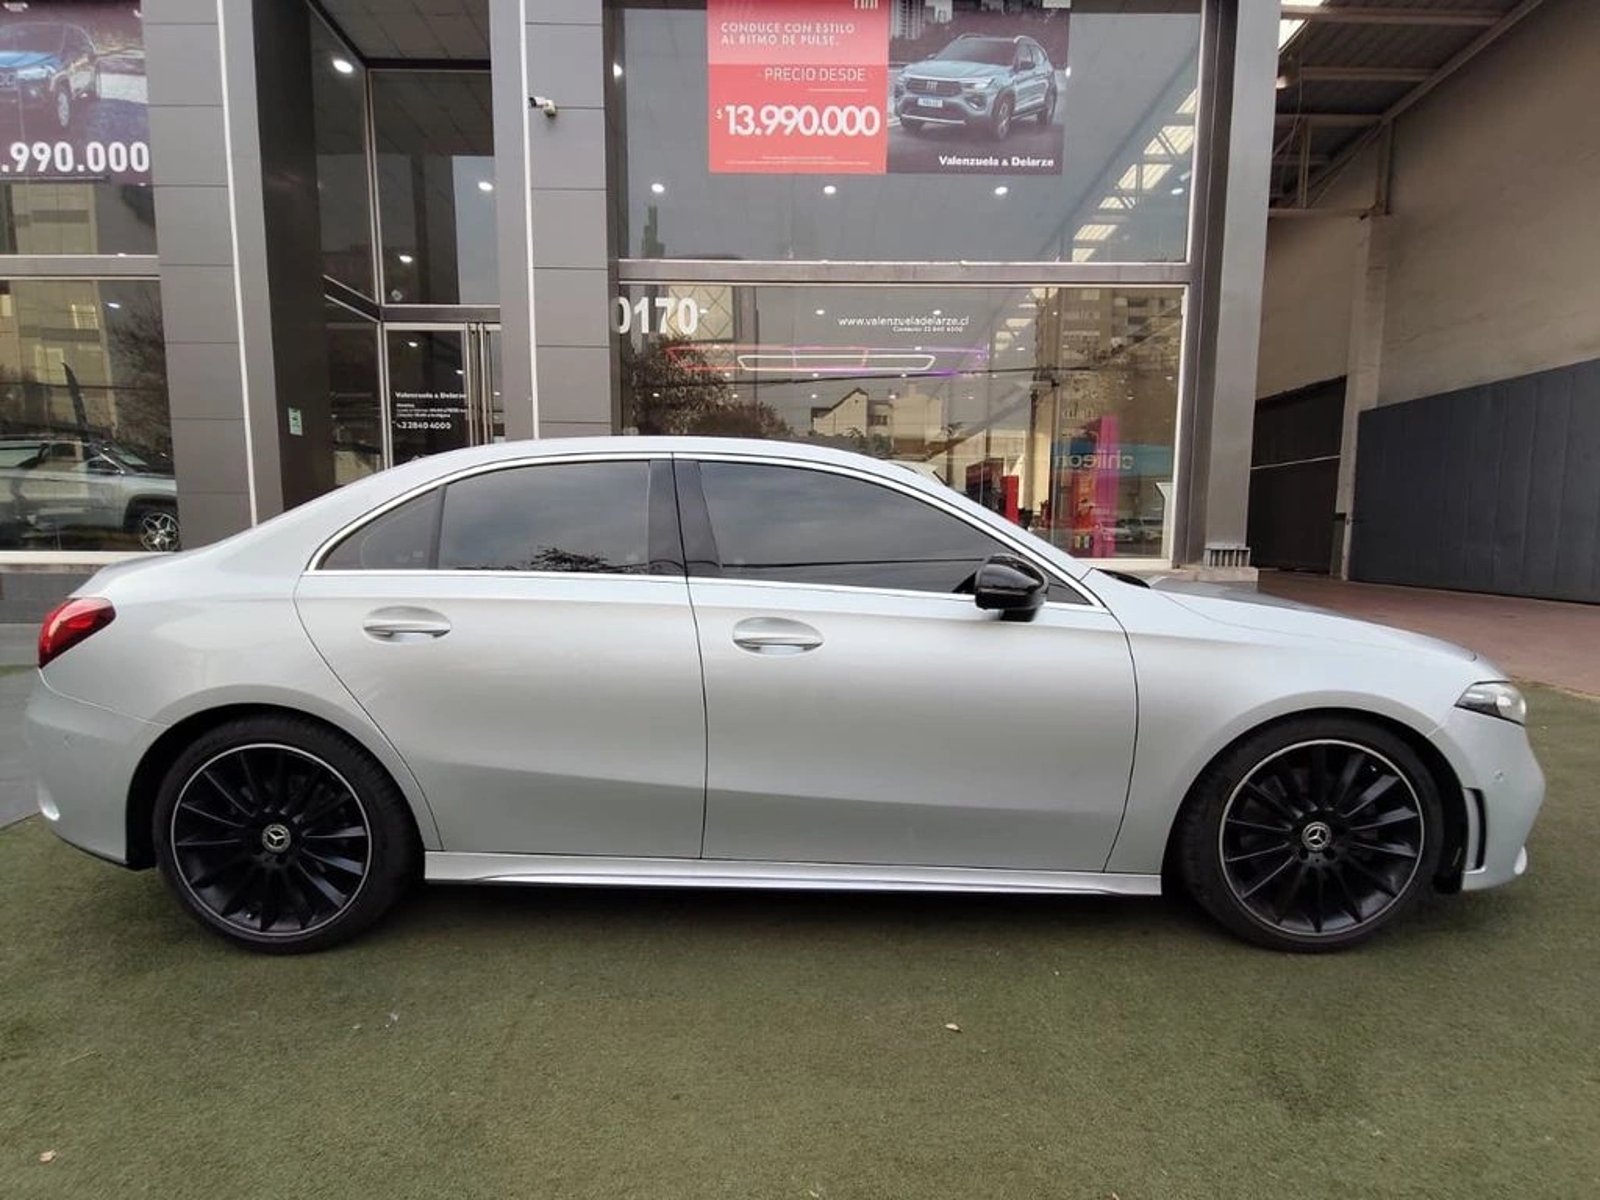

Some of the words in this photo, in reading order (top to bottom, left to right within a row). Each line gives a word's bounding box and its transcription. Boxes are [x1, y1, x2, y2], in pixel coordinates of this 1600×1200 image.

[720, 22, 779, 34] CONDUCE
[784, 22, 812, 34] CON
[816, 23, 855, 34] ESTILO
[720, 34, 734, 45] AL
[738, 34, 776, 45] RITMO
[782, 34, 796, 45] DE
[764, 67, 816, 82] PRECIO
[819, 67, 866, 82] DESDE
[725, 104, 881, 136] 13.990.000
[938, 155, 999, 167] Valenzuela
[1011, 156, 1054, 168] Delarze
